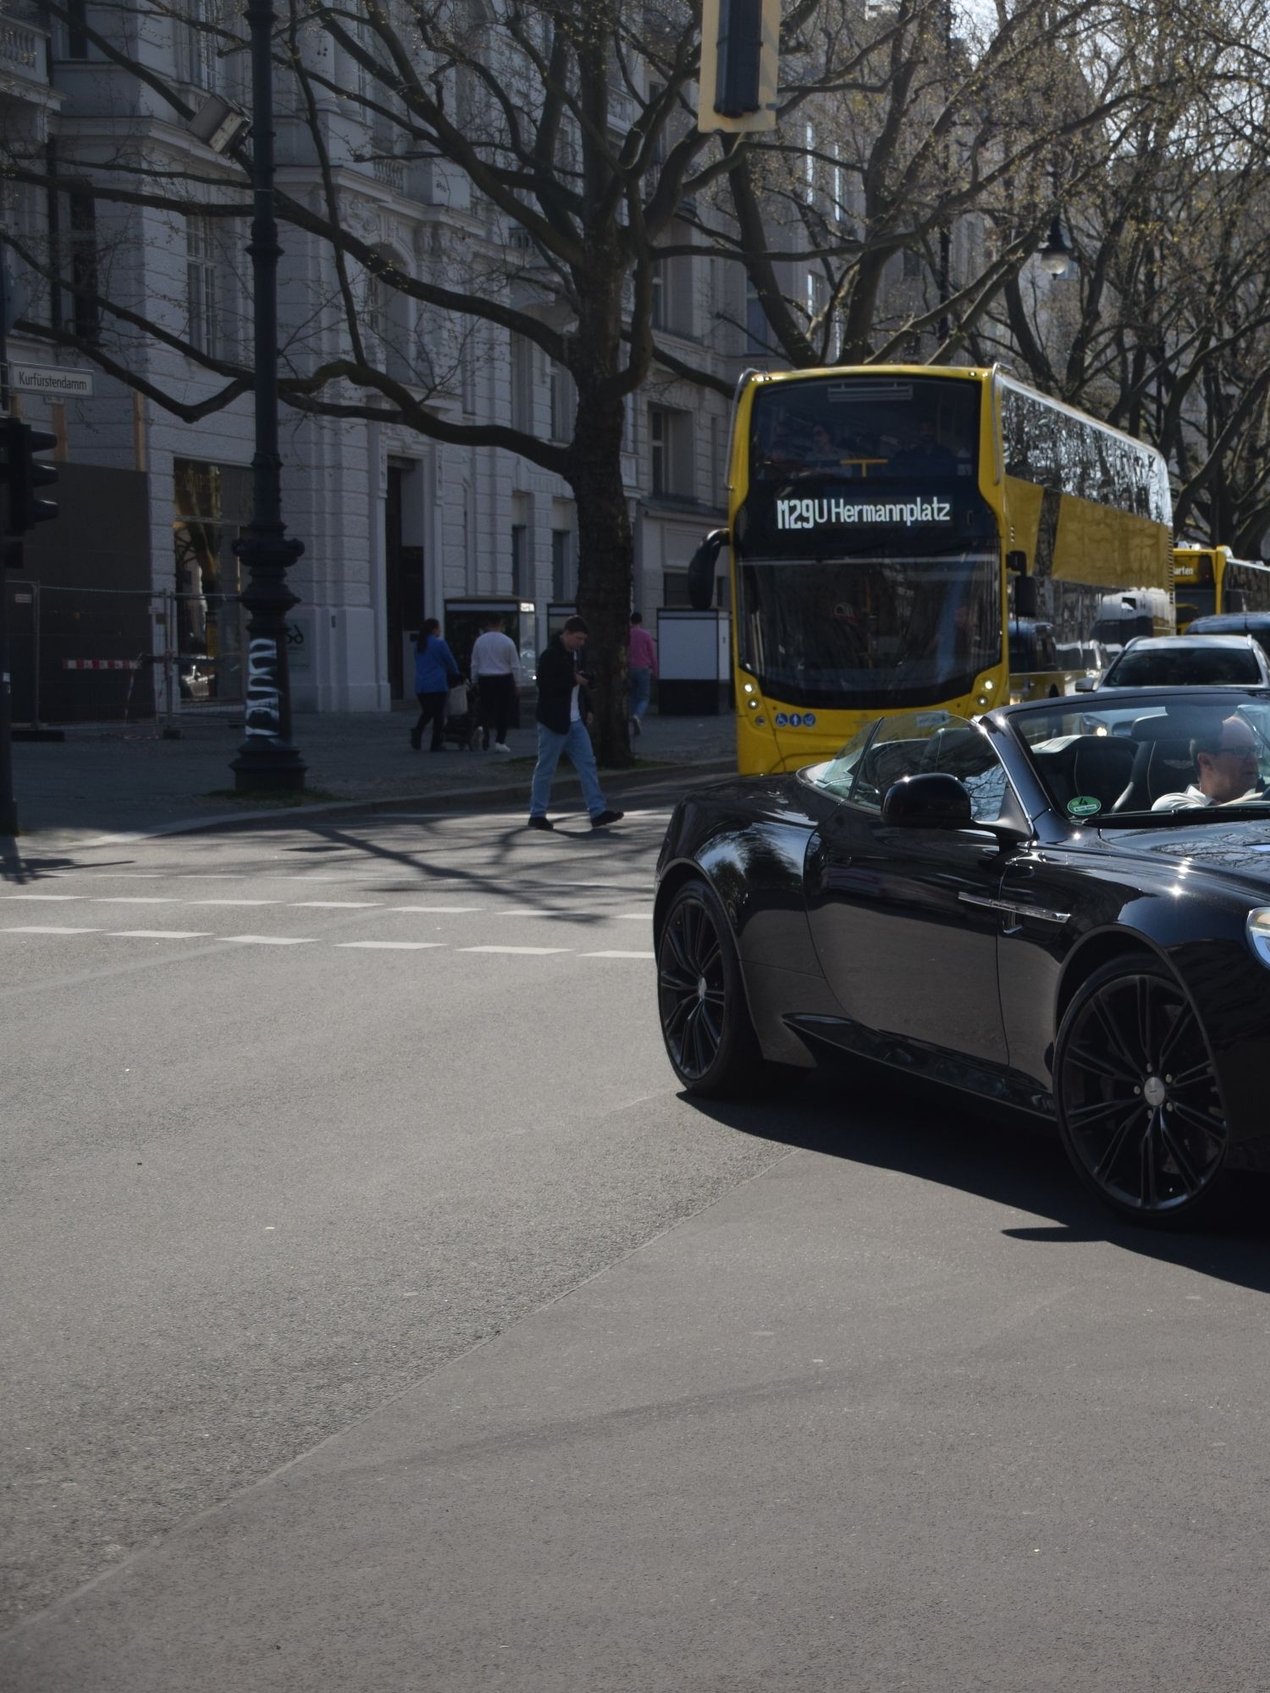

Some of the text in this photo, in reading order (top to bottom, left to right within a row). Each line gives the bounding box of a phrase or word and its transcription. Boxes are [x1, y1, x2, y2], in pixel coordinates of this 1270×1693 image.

[18, 371, 87, 390] Kurfürstendamm
[777, 496, 950, 529] M29 U Hermannplatz
